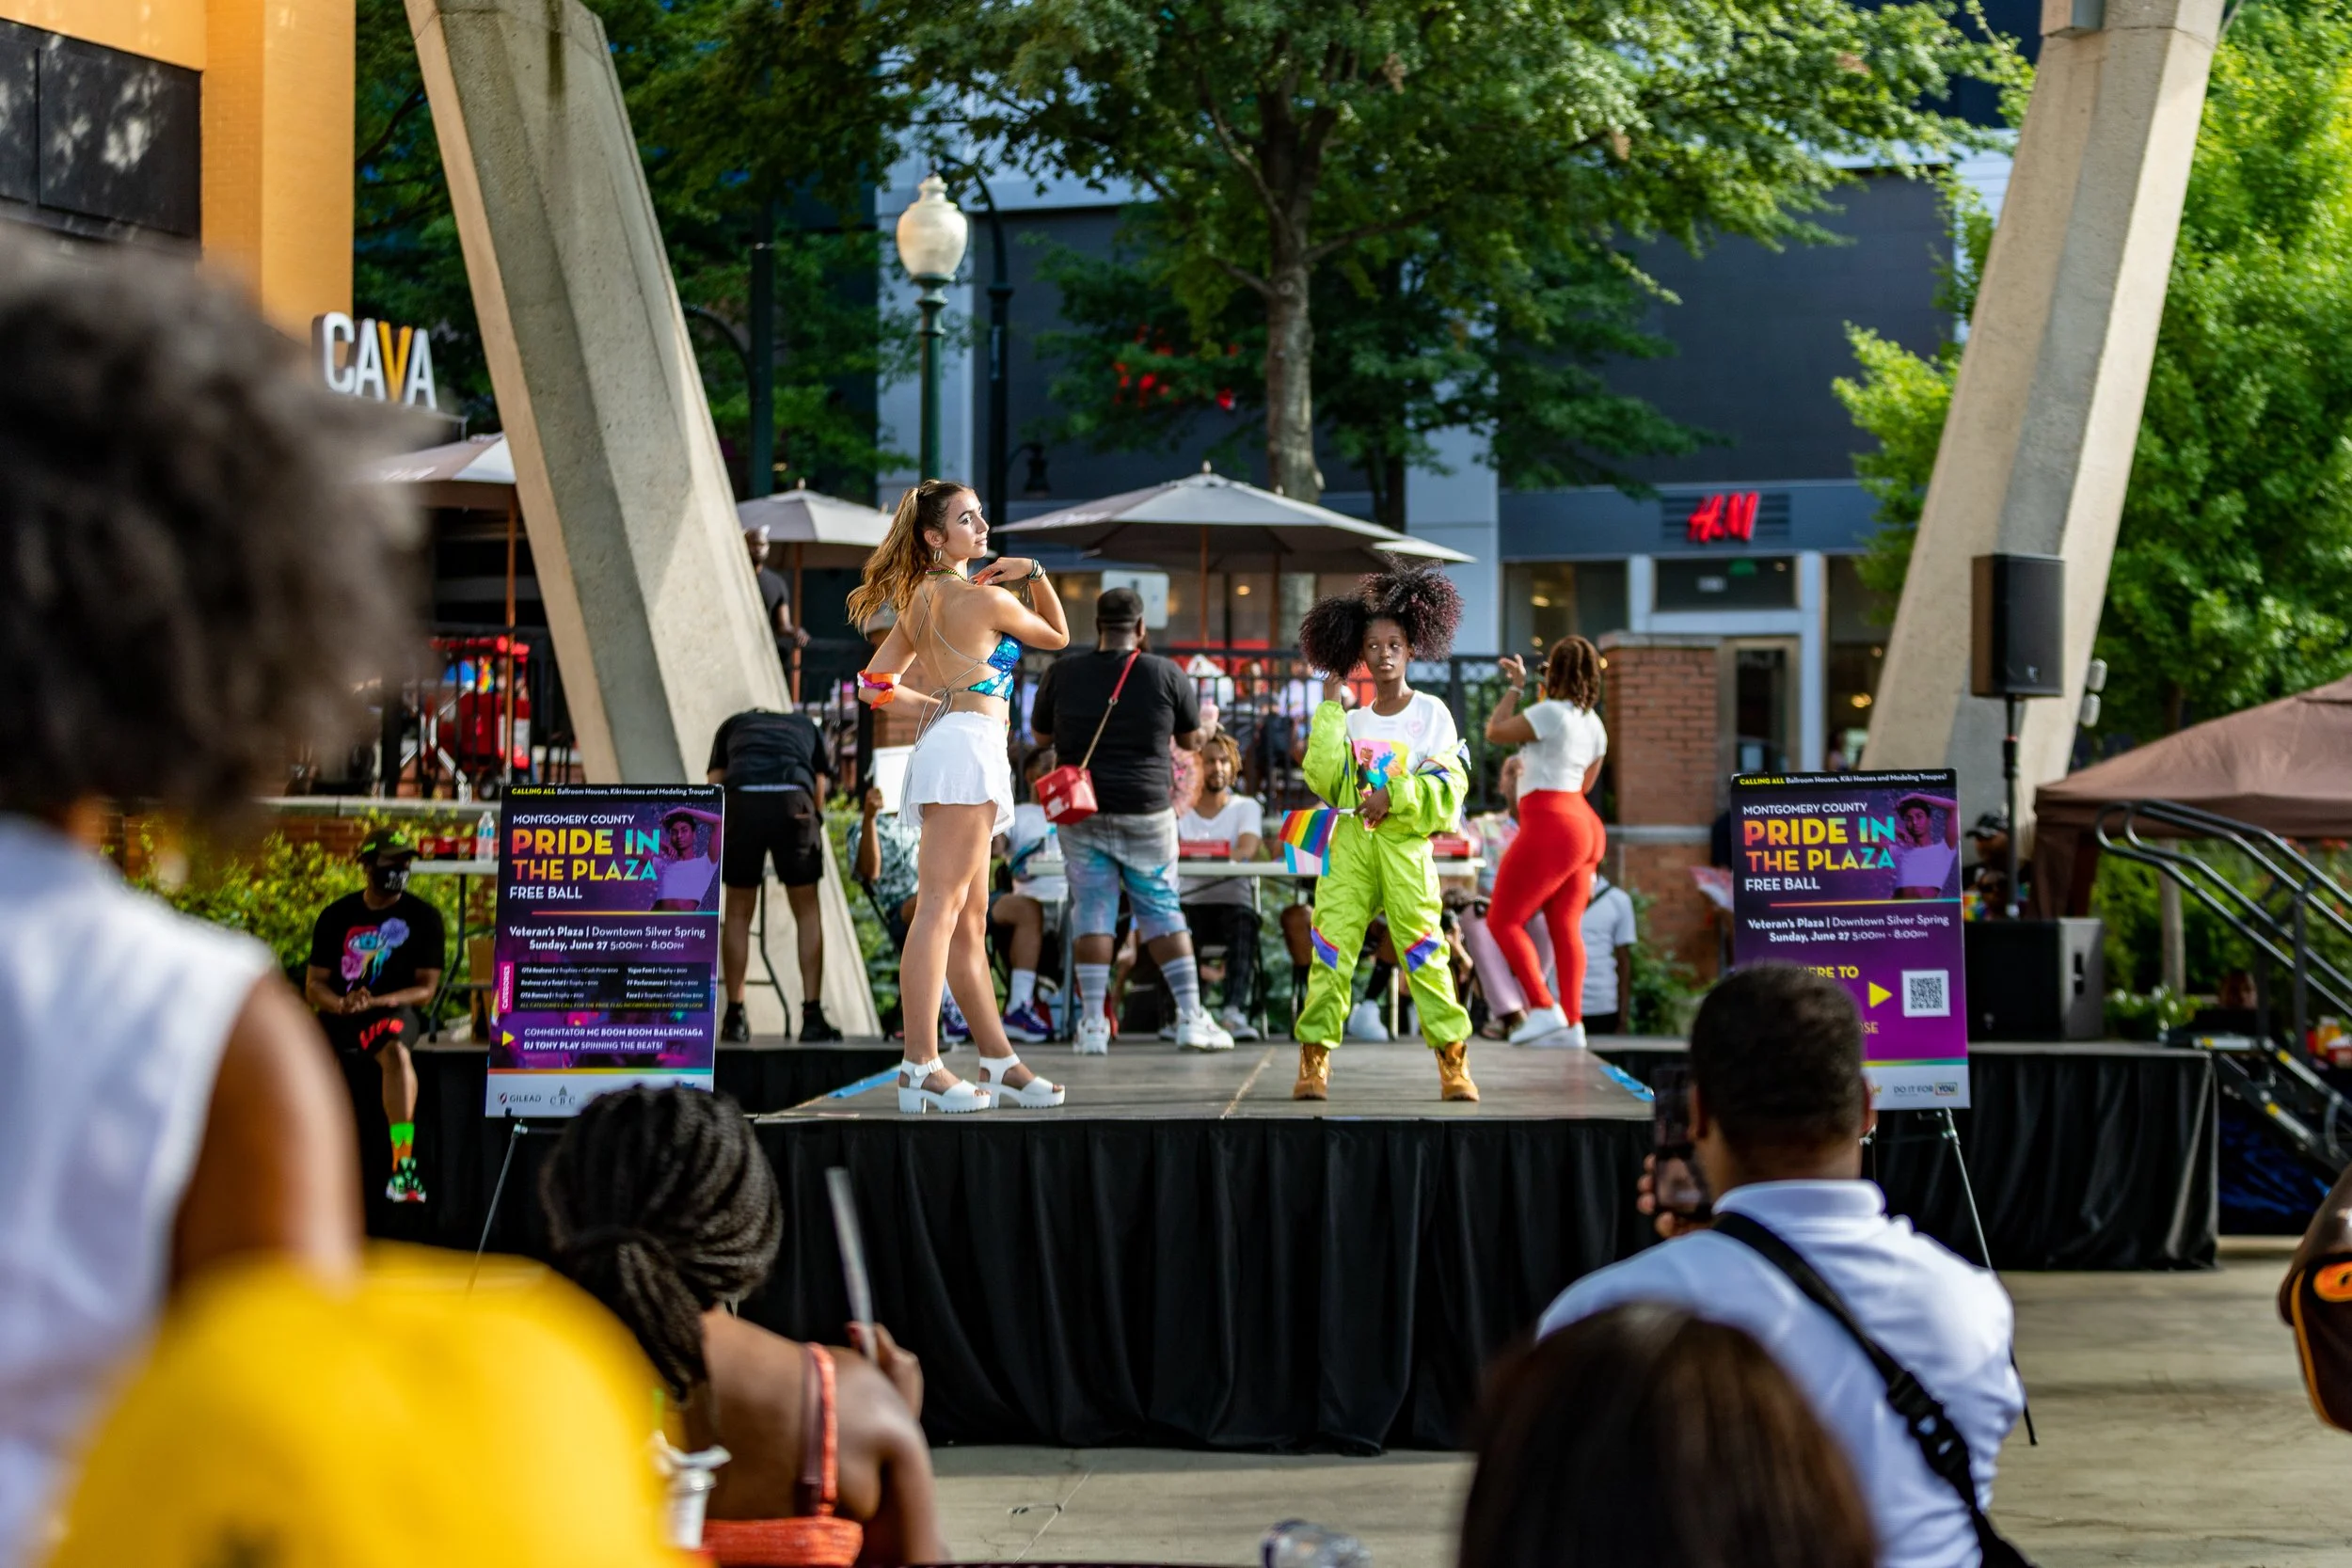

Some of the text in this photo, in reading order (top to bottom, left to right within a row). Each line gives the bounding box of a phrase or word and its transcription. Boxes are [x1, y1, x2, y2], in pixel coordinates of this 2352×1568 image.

[323, 311, 437, 412] CAVA
[1687, 491, 1759, 543] H&M
[1786, 776, 1814, 784] Ballroom
[1815, 776, 1839, 784] Houses,
[1890, 773, 1919, 783] Modeling
[1920, 773, 1947, 782] Troupes!
[688, 788, 714, 797] Troupes!
[1743, 802, 1867, 816] MONTGOMERY COUNTY
[513, 814, 635, 825] MONTGOMERY COUNTY
[1743, 816, 1896, 846] PRIDE IN
[511, 828, 660, 855] PRIDE IN
[1746, 847, 1896, 872] THE PLAZA
[512, 859, 659, 881] THE PLAZA
[1745, 877, 1820, 892] FREE BALL
[509, 886, 583, 900] FREE BALL
[1748, 918, 1795, 929] Veteran's
[1797, 917, 1825, 927] Plaza
[1832, 916, 1885, 927] Downtown
[1886, 915, 1915, 926] Silver
[1916, 914, 1949, 927] Spring
[509, 926, 555, 937] Veteran's
[557, 926, 583, 937] Plaza
[592, 927, 644, 937] Downtown
[645, 926, 674, 937] Silver
[675, 926, 706, 939] Spring
[1770, 931, 1809, 942] Sunday,
[1811, 932, 1836, 942] June
[1837, 931, 1850, 942] 27
[1851, 931, 1886, 941] 5:00PM
[1894, 929, 1929, 940] 8:00PM
[529, 941, 568, 952] Sunday,
[570, 941, 594, 950] June
[596, 941, 608, 950] 27
[610, 941, 644, 950] 5:00PM
[651, 941, 685, 950] 8:00PM
[1837, 965, 1860, 978] TO
[524, 1028, 704, 1037] COMMENTATOR MC BOOM BOOM BALENCIAGA
[523, 1042, 662, 1051] DJ TONY PLAY SPINNING THE BEATS!
[1893, 1085, 1906, 1094] DO
[1917, 1085, 1934, 1093] FOR
[1938, 1084, 1955, 1092] YOU
